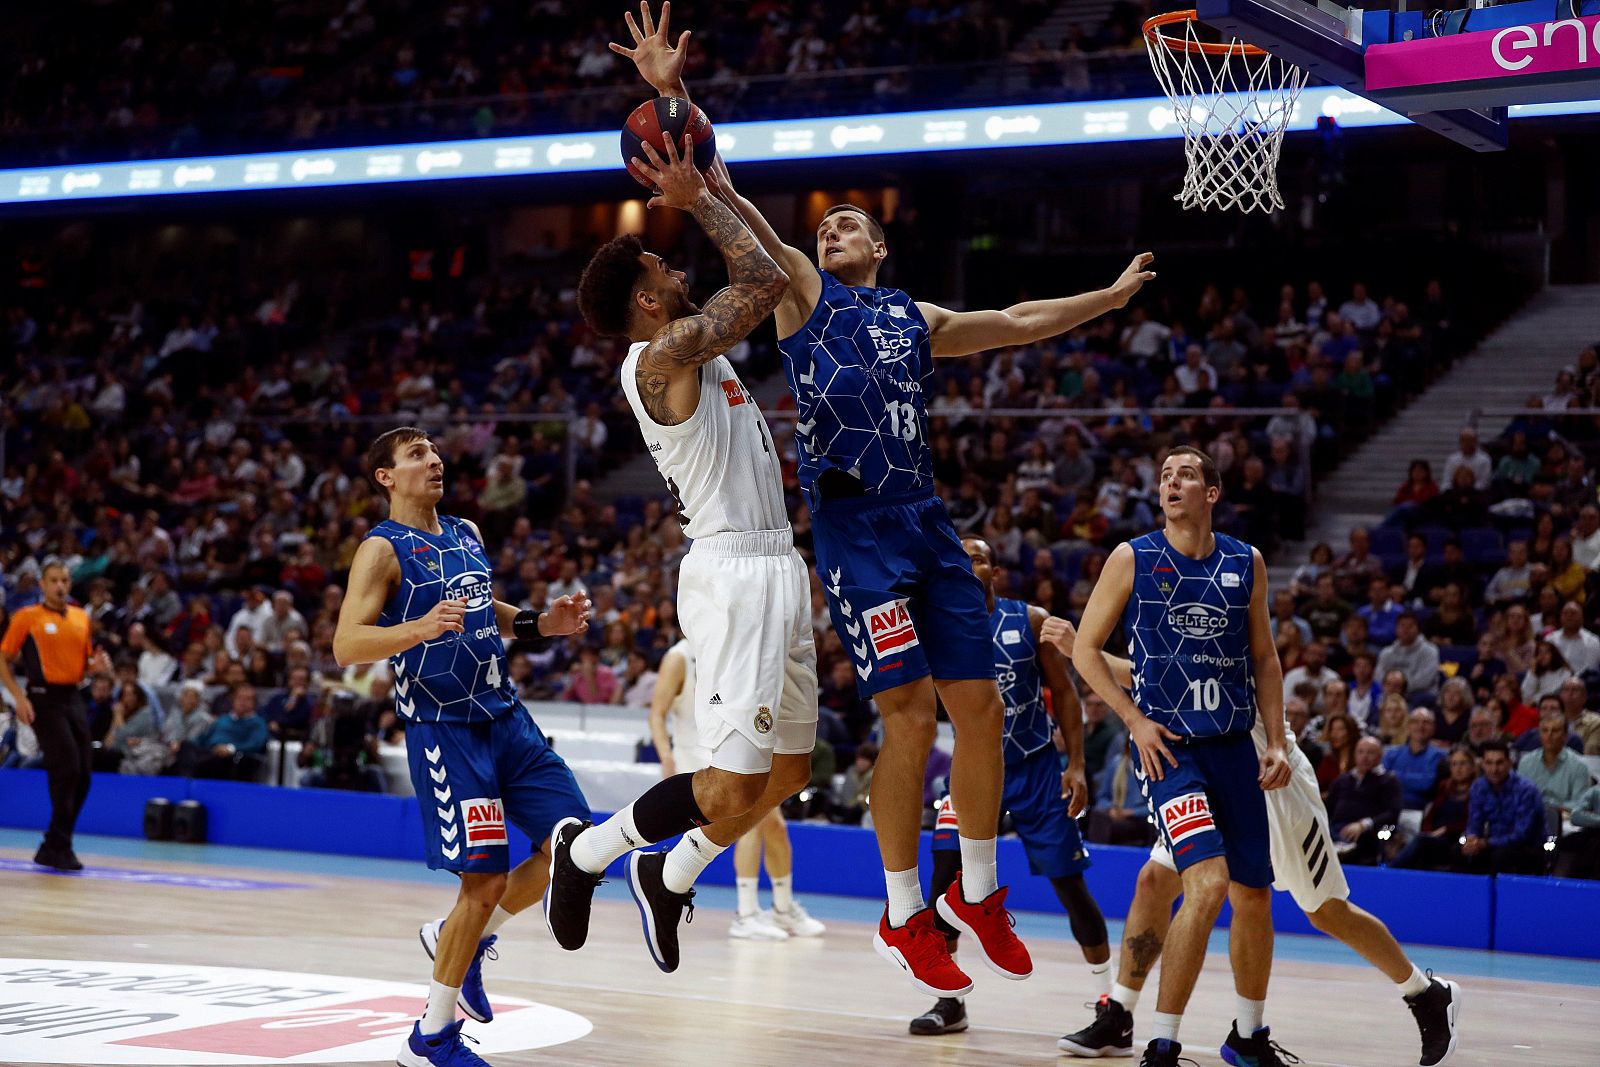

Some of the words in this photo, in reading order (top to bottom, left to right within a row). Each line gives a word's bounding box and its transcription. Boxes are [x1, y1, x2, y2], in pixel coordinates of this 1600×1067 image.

[886, 400, 917, 441] 13
[1167, 614, 1229, 628] DELTECO
[485, 653, 502, 689] 4
[1189, 677, 1220, 711] 10
